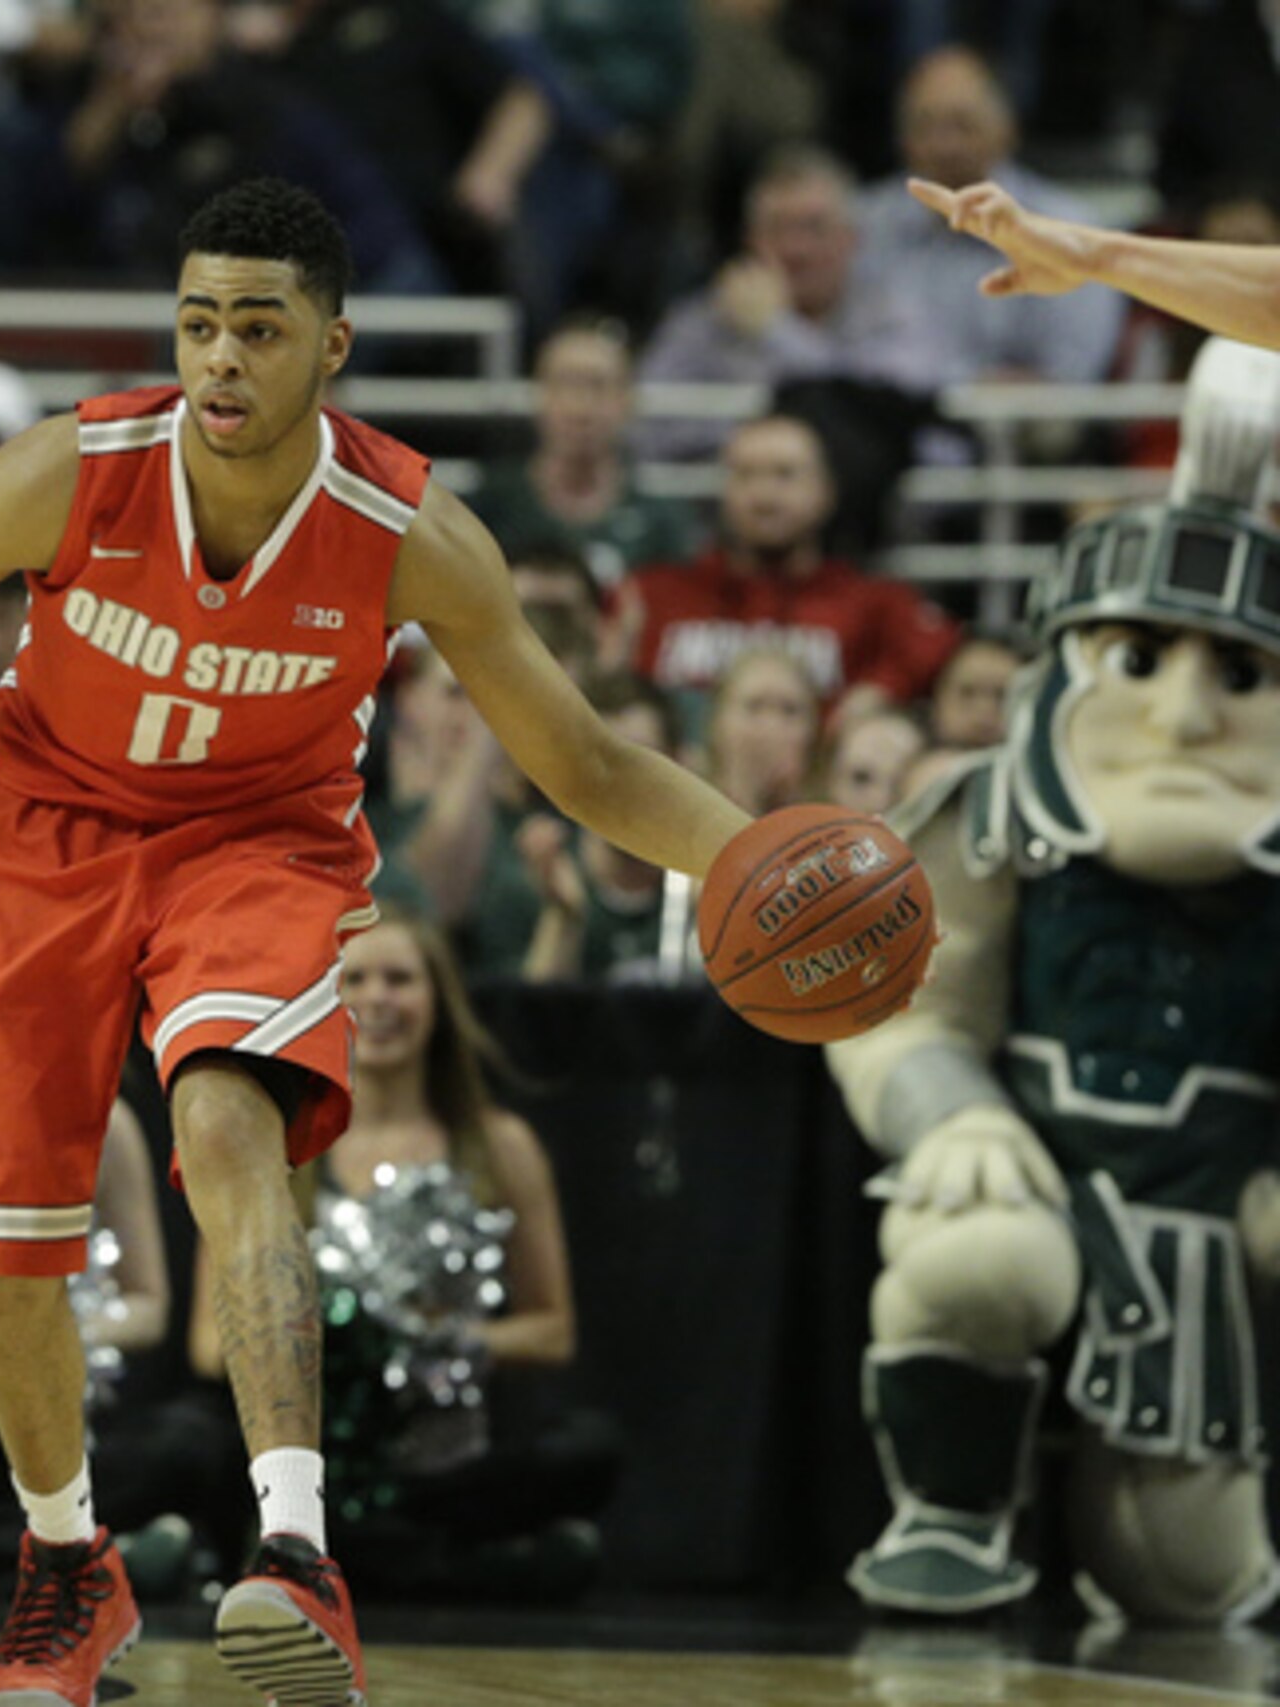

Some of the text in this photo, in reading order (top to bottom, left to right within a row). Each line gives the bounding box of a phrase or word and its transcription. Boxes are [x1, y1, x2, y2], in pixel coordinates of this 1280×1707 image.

[62, 587, 337, 695] OHIO STATE
[779, 883, 922, 996] SPALDING
